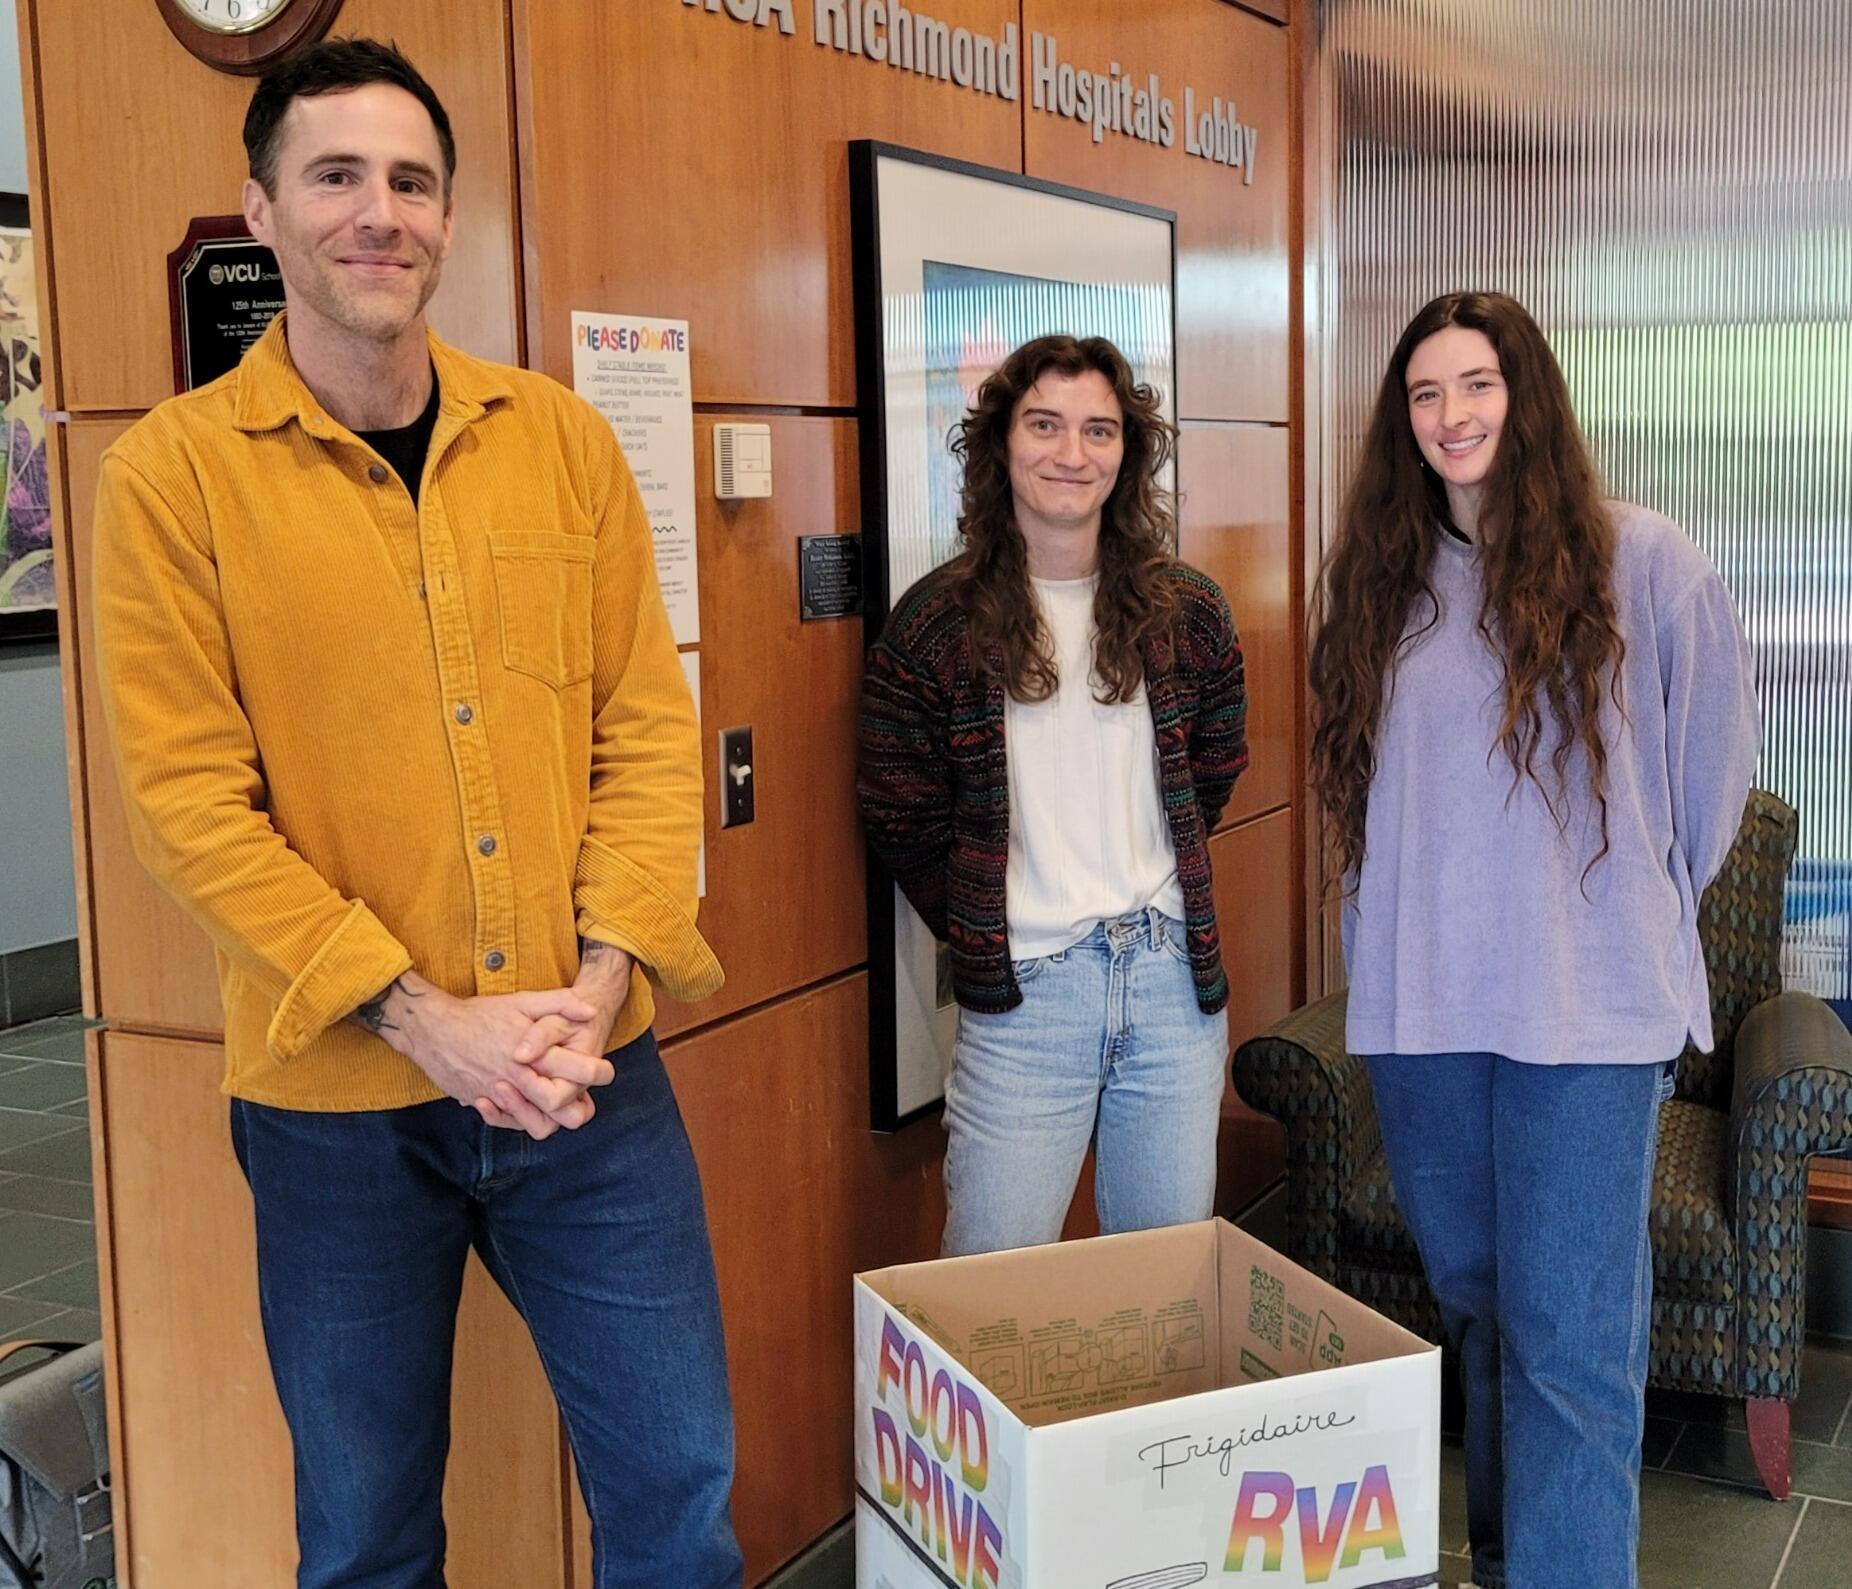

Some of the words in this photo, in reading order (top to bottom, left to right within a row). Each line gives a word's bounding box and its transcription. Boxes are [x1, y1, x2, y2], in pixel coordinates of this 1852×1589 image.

[1031, 31, 1175, 147] Hospitals
[1183, 86, 1257, 185] Lobby
[223, 263, 260, 282] VCU
[630, 327, 686, 353] DONATE
[877, 1310, 988, 1492] FOOD
[1138, 1411, 1356, 1490] Frigidaire
[872, 1406, 1002, 1589] DRIVE
[1223, 1464, 1406, 1584] RVA
